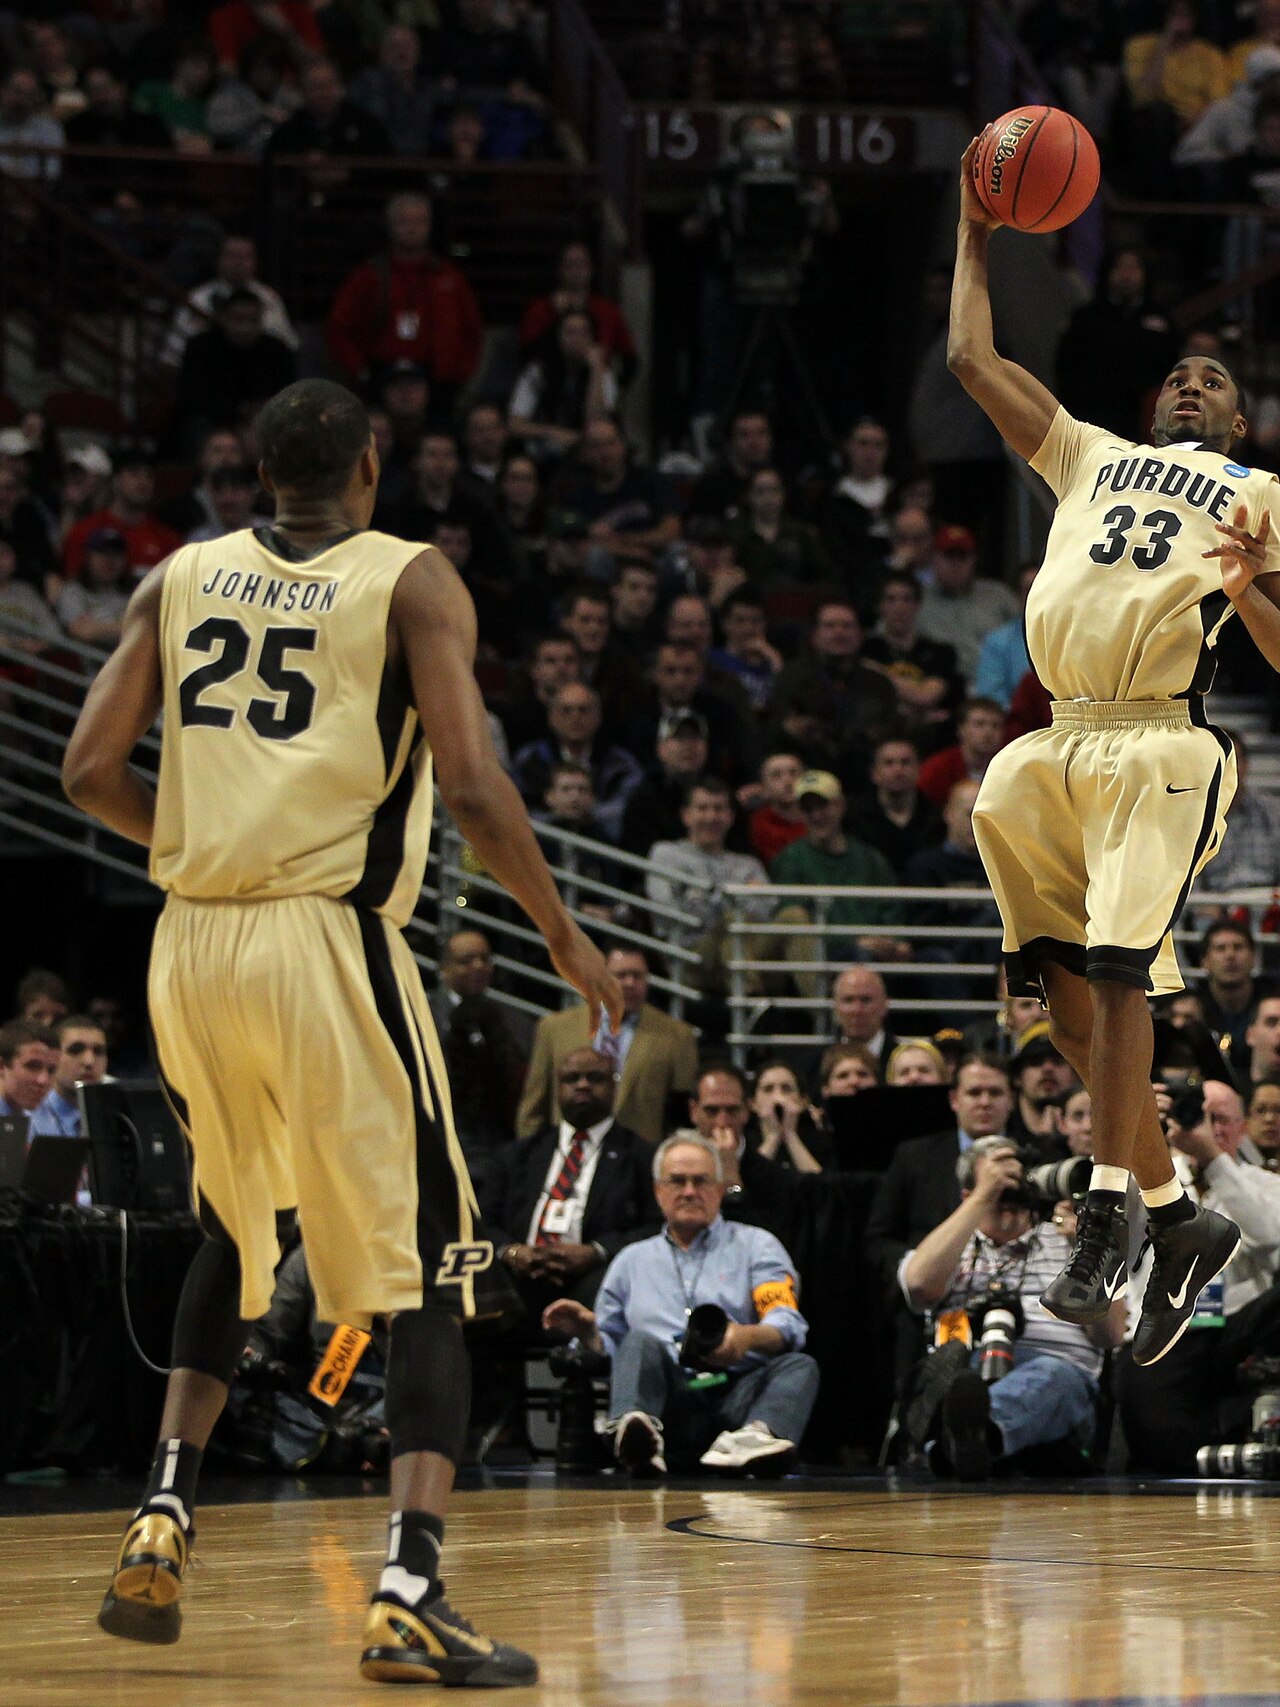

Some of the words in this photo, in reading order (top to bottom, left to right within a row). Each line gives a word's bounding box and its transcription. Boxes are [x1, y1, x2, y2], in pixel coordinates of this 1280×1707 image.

[816, 113, 896, 164] 116
[990, 116, 1036, 194] Wilson
[1089, 456, 1236, 523] PURDUE
[1088, 504, 1183, 571] 33
[202, 568, 339, 612] JOHNSON
[179, 616, 318, 742] 25
[435, 1241, 494, 1287] P
